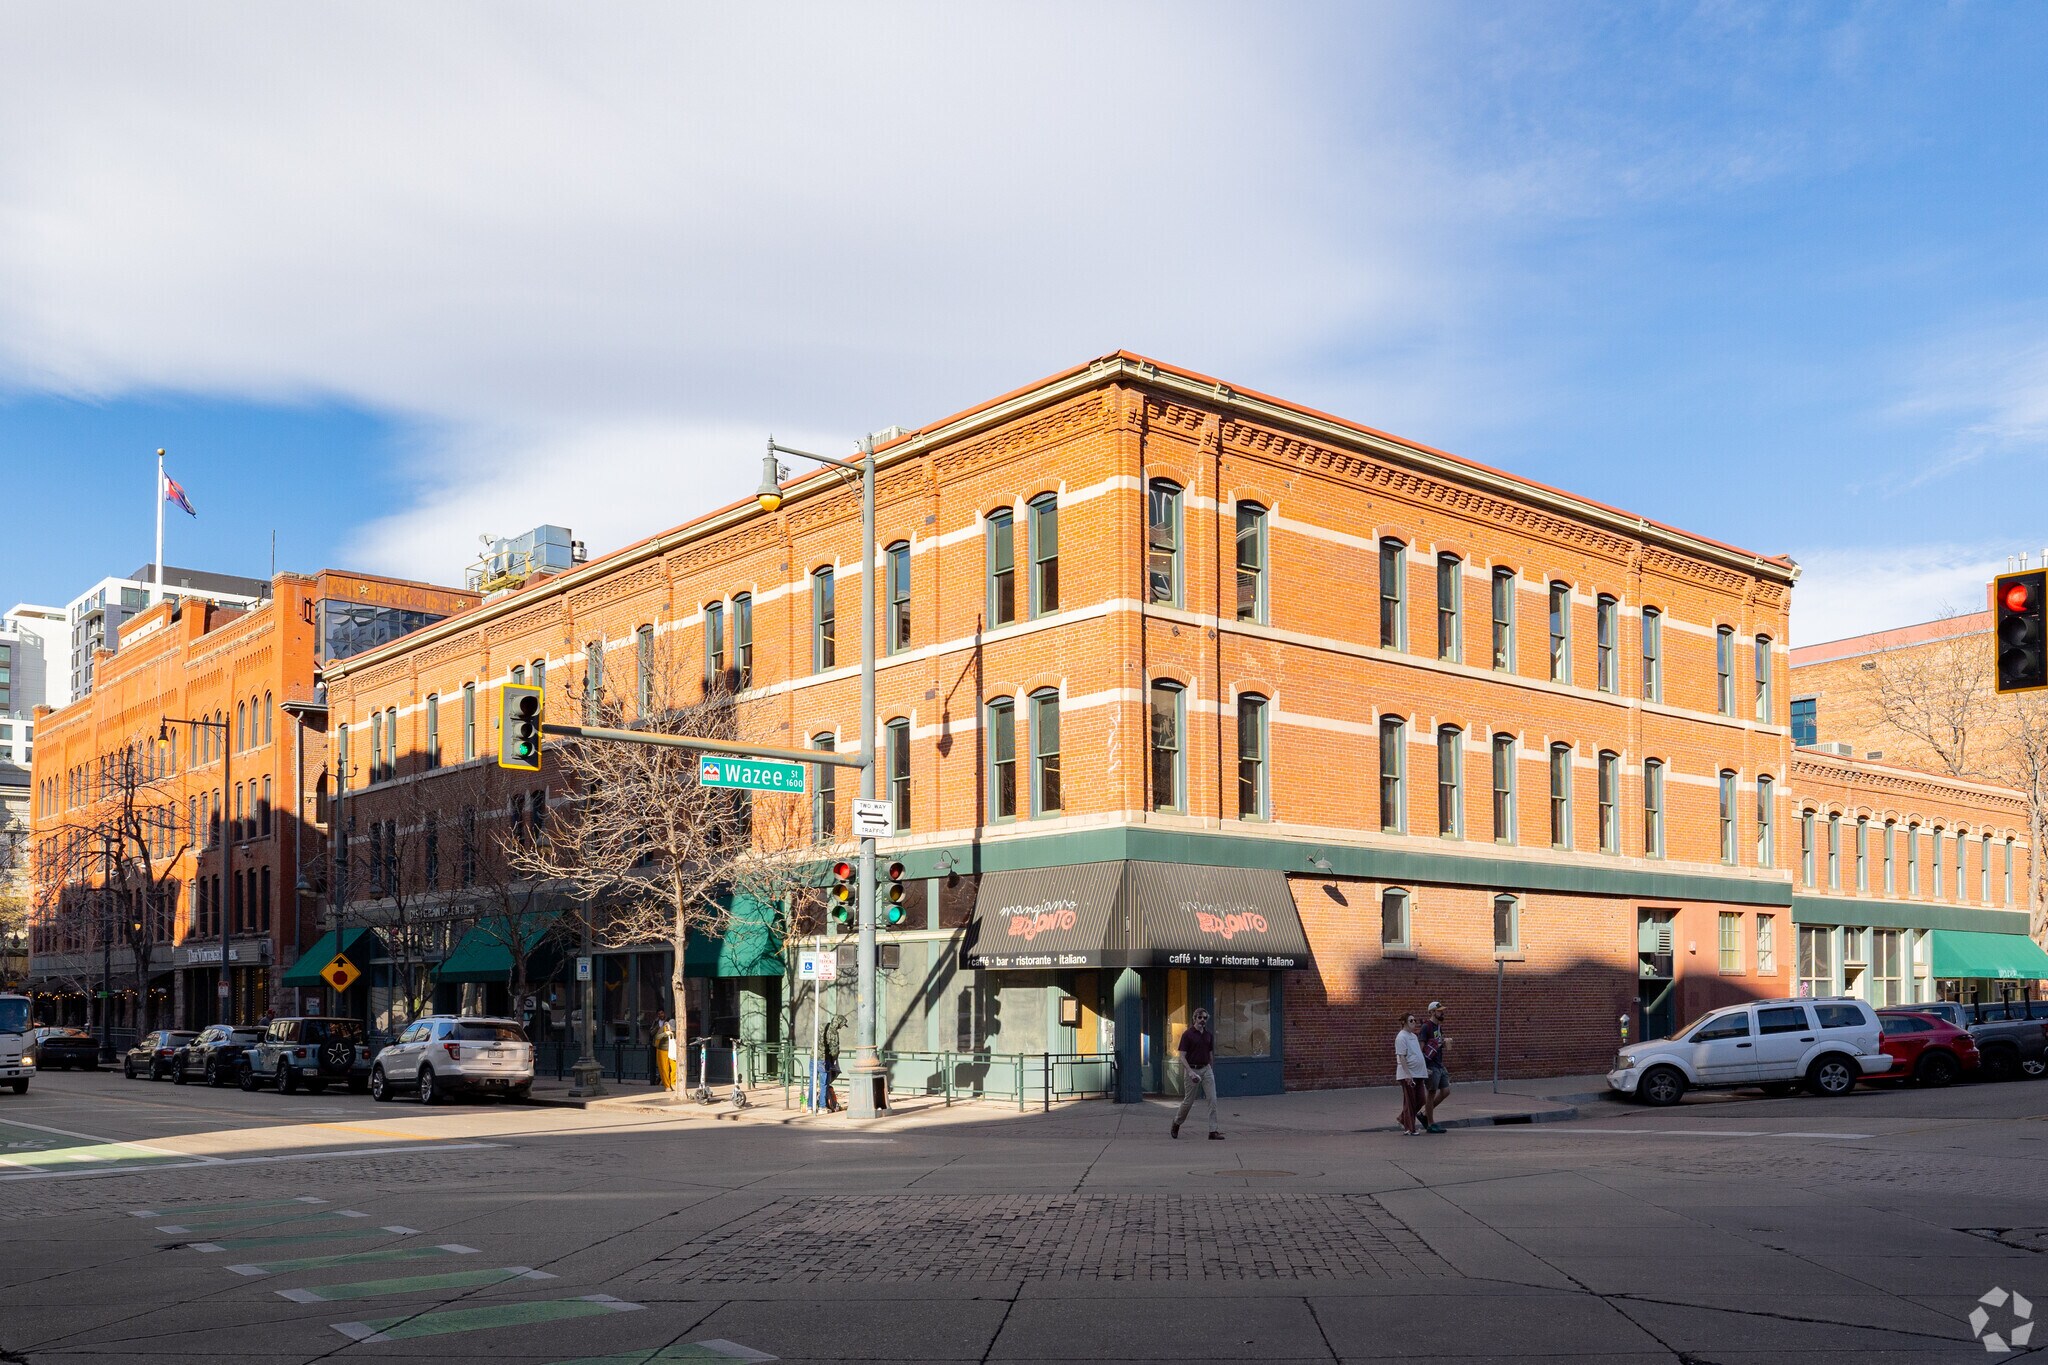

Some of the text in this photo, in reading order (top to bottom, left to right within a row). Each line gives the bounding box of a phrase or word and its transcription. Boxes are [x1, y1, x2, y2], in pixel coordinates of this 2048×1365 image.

[725, 763, 783, 786] Wazee
[791, 769, 798, 778] St
[786, 779, 803, 788] 1600
[971, 953, 1087, 967] caffé bar ristorante italiano
[1169, 953, 1295, 967] caffé bar ristorante italiano
